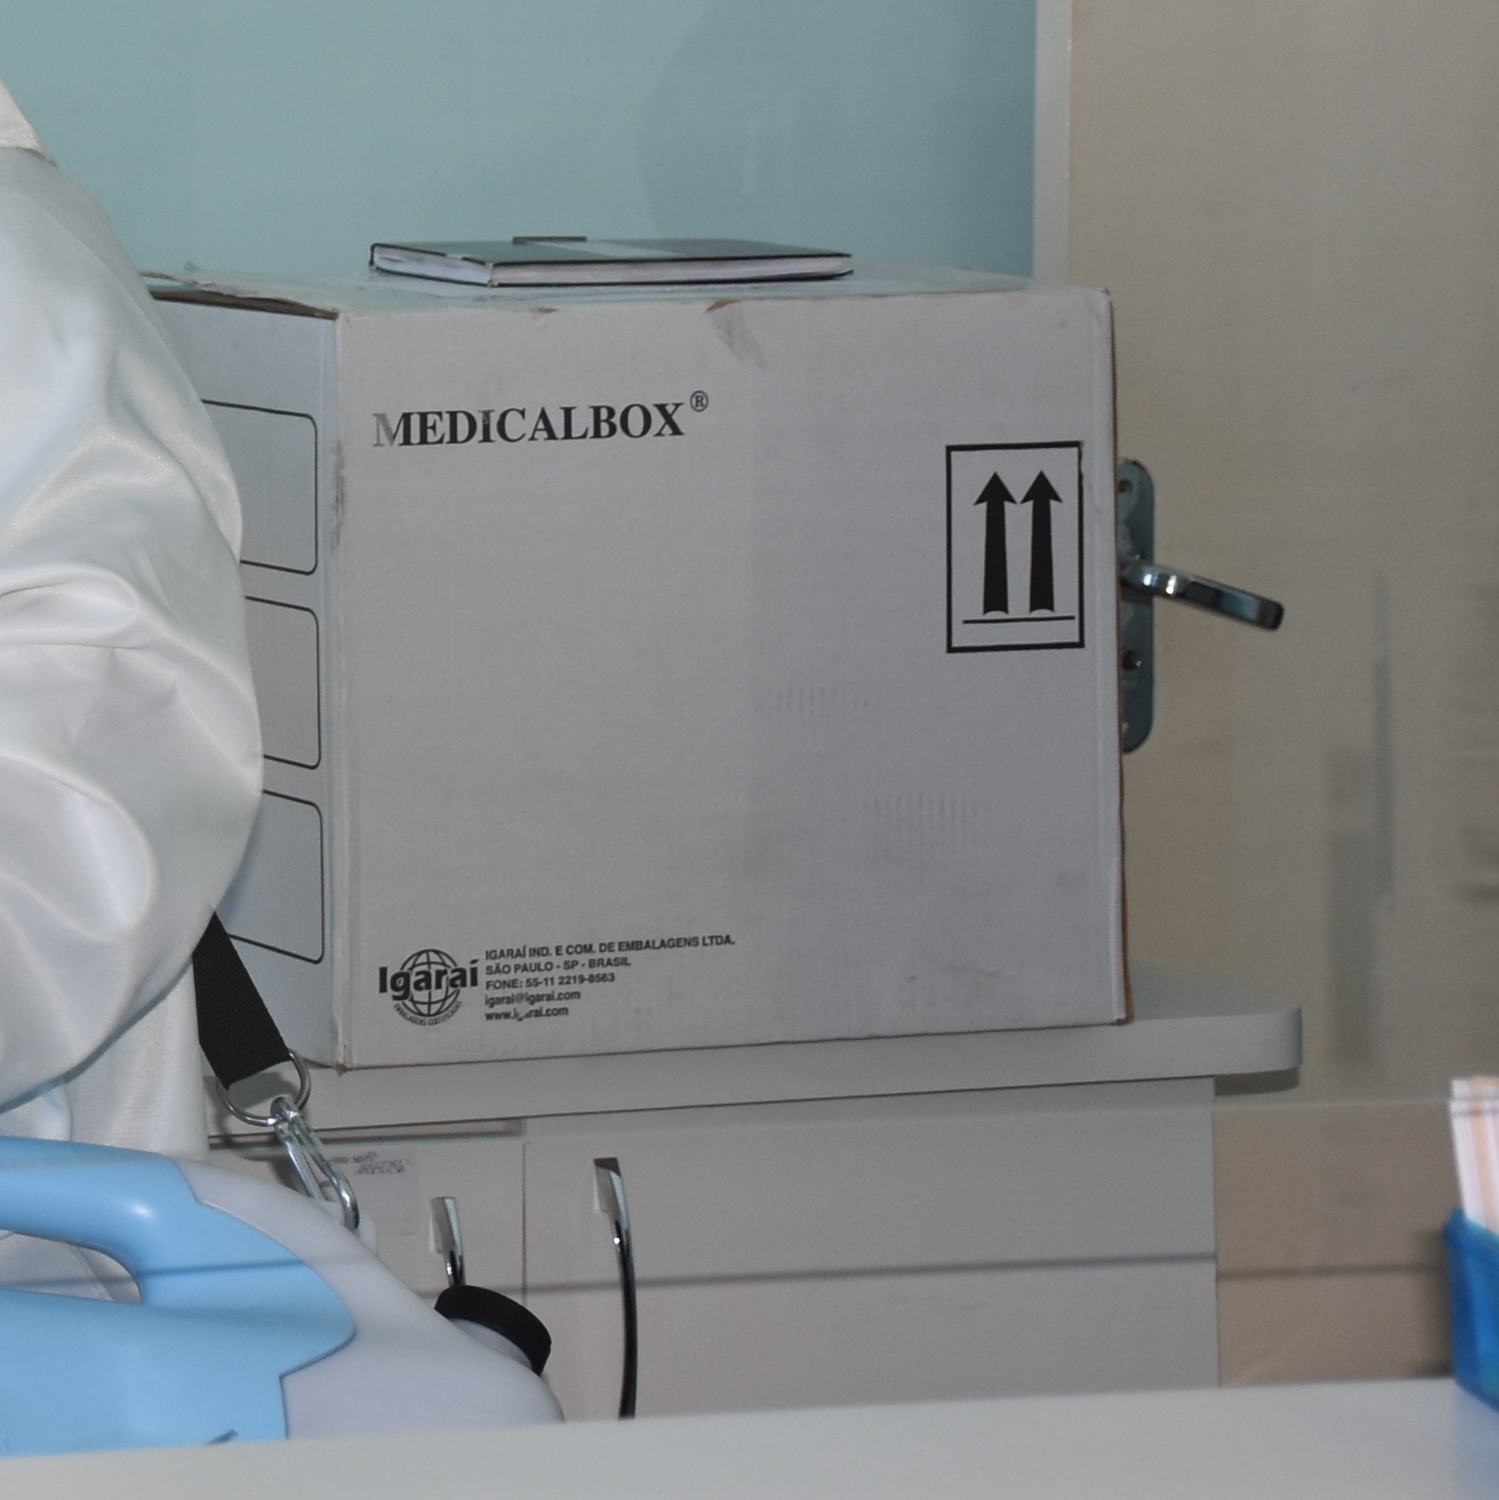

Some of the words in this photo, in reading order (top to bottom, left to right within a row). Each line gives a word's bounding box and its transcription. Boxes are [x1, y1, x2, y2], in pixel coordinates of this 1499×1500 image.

[485, 944, 527, 960] IGARAÍ
[528, 946, 552, 958] IND.
[555, 945, 563, 956] E
[565, 943, 596, 956] COM.
[598, 942, 616, 953] DE
[617, 936, 700, 952] EMBALAGENS
[701, 934, 736, 947] LTDA.
[485, 962, 511, 975] SÃO
[513, 961, 553, 974] PAULO
[563, 960, 579, 970] SP
[588, 957, 632, 969] BRASIL
[379, 958, 480, 1001] Igaraí
[485, 979, 524, 991] FONE:
[525, 976, 555, 987] 55-11
